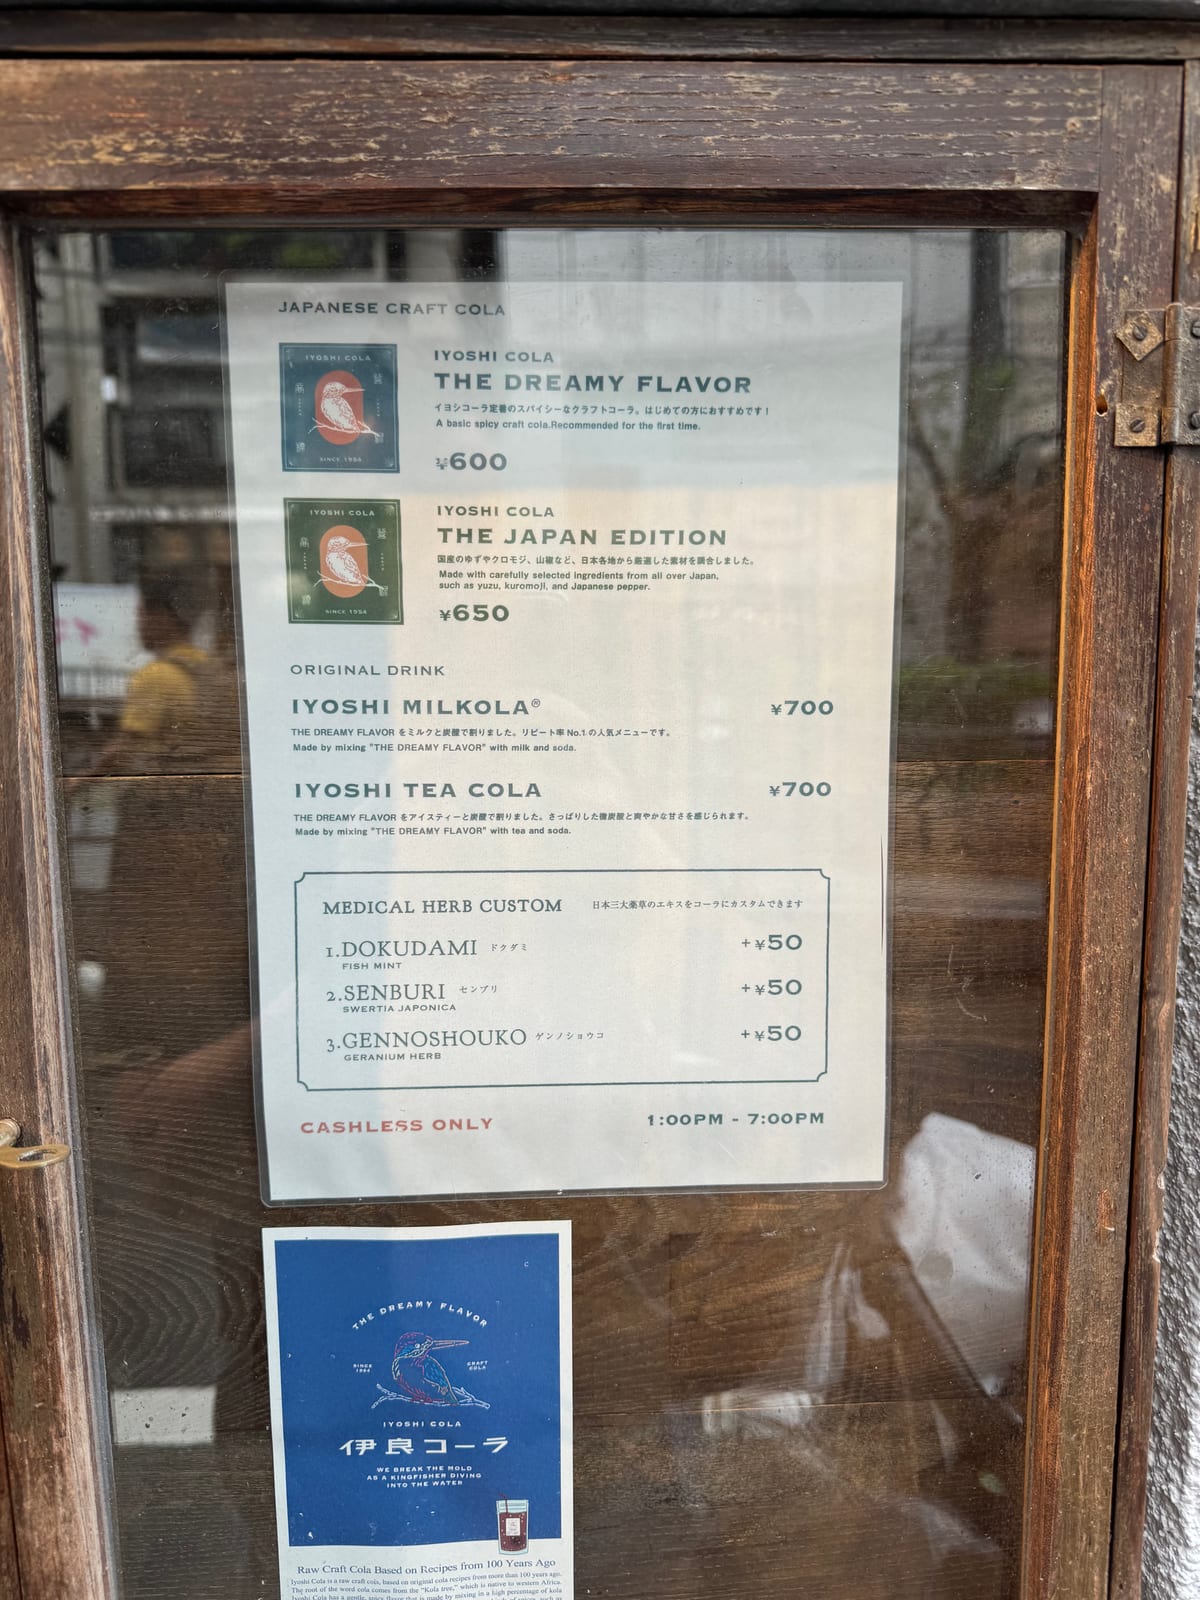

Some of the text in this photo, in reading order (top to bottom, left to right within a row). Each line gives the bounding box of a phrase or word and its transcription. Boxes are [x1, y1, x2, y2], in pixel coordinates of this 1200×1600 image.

[278, 301, 505, 316] JAPANESE CRAFT COLA
[434, 349, 554, 363] IYOSHI COLA
[433, 372, 751, 393] THE DREAMY FLAVOR
[435, 418, 443, 427] A
[446, 418, 471, 428] basic
[474, 419, 499, 429] spicy
[502, 419, 524, 429] craft
[621, 420, 636, 430] for
[638, 421, 654, 430] the
[656, 421, 675, 430] first
[677, 421, 700, 430] time.
[437, 505, 554, 517] IYOSHI COLA
[436, 527, 726, 545] THE JAPAN EDITION
[439, 569, 719, 581] Made with carefully selected ingredients from all over Japan,
[439, 580, 461, 589] such
[504, 581, 548, 591] kuromoji,
[551, 582, 568, 590] and
[570, 582, 614, 591] Japanese
[616, 583, 650, 591] pepper.
[439, 603, 509, 622] ¥650
[290, 664, 444, 676] ORIGINAL DRINK
[292, 698, 389, 714] IYOSHI
[770, 699, 834, 715] ¥700
[290, 728, 395, 737] THE DREAMY FLAVOR
[293, 743, 318, 751] Made
[320, 743, 332, 752] by
[335, 743, 366, 752] mixing
[397, 743, 439, 752] DREAMY
[489, 743, 508, 751] with
[511, 743, 530, 751] milk
[533, 743, 550, 751] and
[552, 743, 577, 752] soda.
[295, 782, 541, 798] IYOSHI TEA COLA
[769, 781, 832, 797] ¥700
[293, 813, 397, 822] THE DREAMY FLAVOR
[295, 827, 320, 836] Made
[322, 827, 334, 836] by
[336, 827, 368, 836] mixing
[398, 827, 440, 835] DREAMY
[489, 826, 509, 834] with
[511, 827, 526, 835] tea
[528, 826, 545, 835] and
[547, 826, 571, 834] soda.
[322, 898, 562, 915] MEDICAL HERB CUSTOM
[592, 899, 803, 910] 日本三大薬草のエキスをコーラにカスタムできます
[491, 943, 527, 952] ドクダミ
[342, 961, 402, 970] FISH MINT
[459, 984, 497, 994] センブリ
[342, 1003, 456, 1013] SWERTIA JAPONICA
[535, 1031, 604, 1040] ゲンノショウコ
[343, 1052, 441, 1061] GERANIUM HERB
[647, 1113, 723, 1126] 1:00PM
[747, 1112, 824, 1125] 7:00PM
[300, 1117, 493, 1134] CASHLESS ONLY
[352, 1301, 488, 1330] THE DREAMY FLAVOR
[339, 1436, 508, 1456] 伊良コーラ
[297, 1566, 319, 1574] Raw
[322, 1565, 347, 1573] Craft
[350, 1565, 371, 1574] Cola
[374, 1566, 402, 1574] Based
[420, 1565, 457, 1574] Recipes
[460, 1562, 484, 1570] from
[487, 1560, 502, 1569] 100
[506, 1560, 532, 1568] Years
[536, 1560, 556, 1568] Ago
